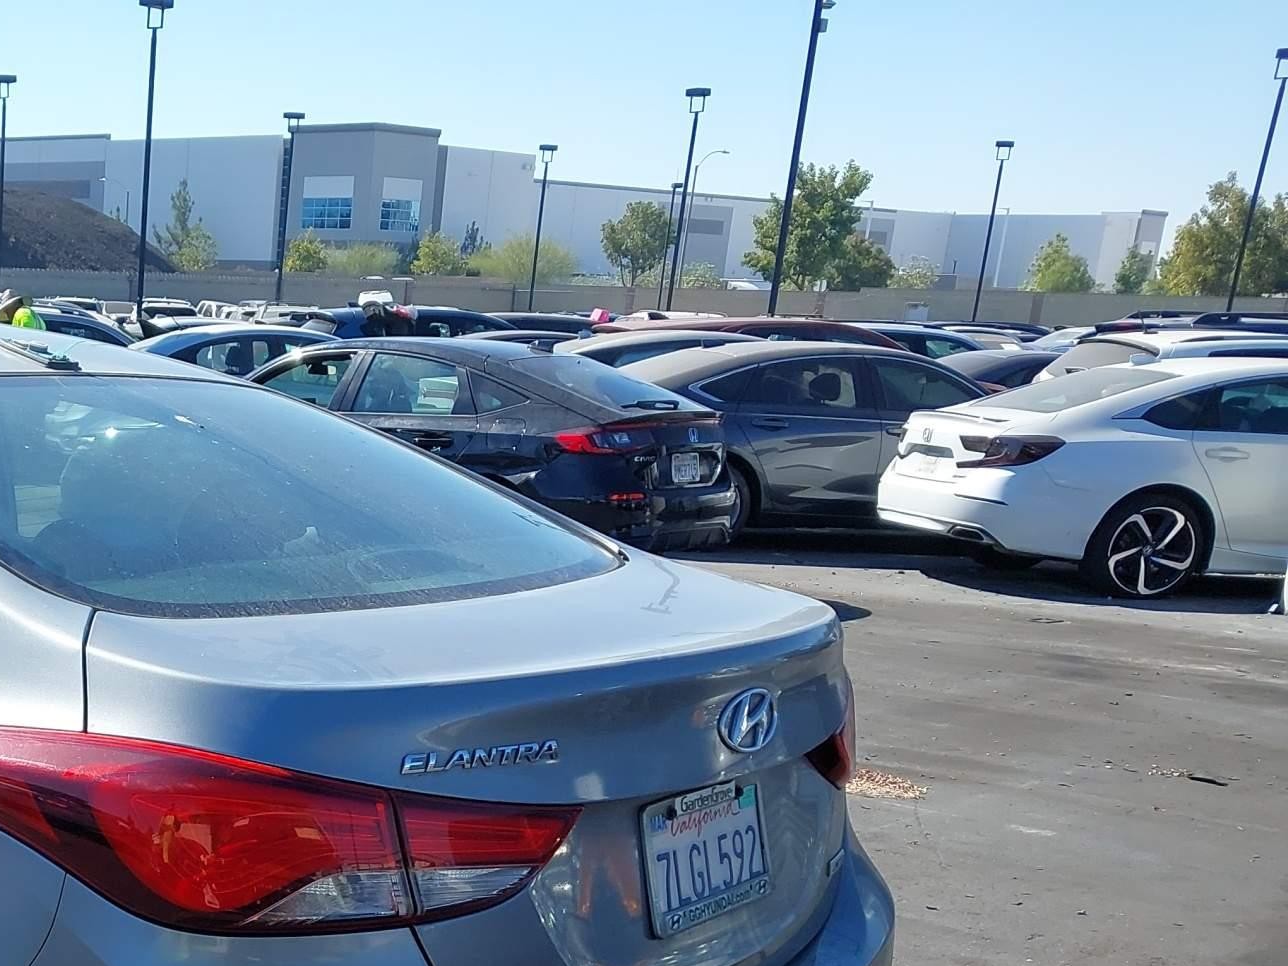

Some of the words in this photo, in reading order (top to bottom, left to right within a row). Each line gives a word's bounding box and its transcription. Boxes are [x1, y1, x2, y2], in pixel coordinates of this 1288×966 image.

[401, 739, 559, 775] ELANTRA
[670, 804, 741, 838] California
[655, 824, 762, 911] 7LGL592
